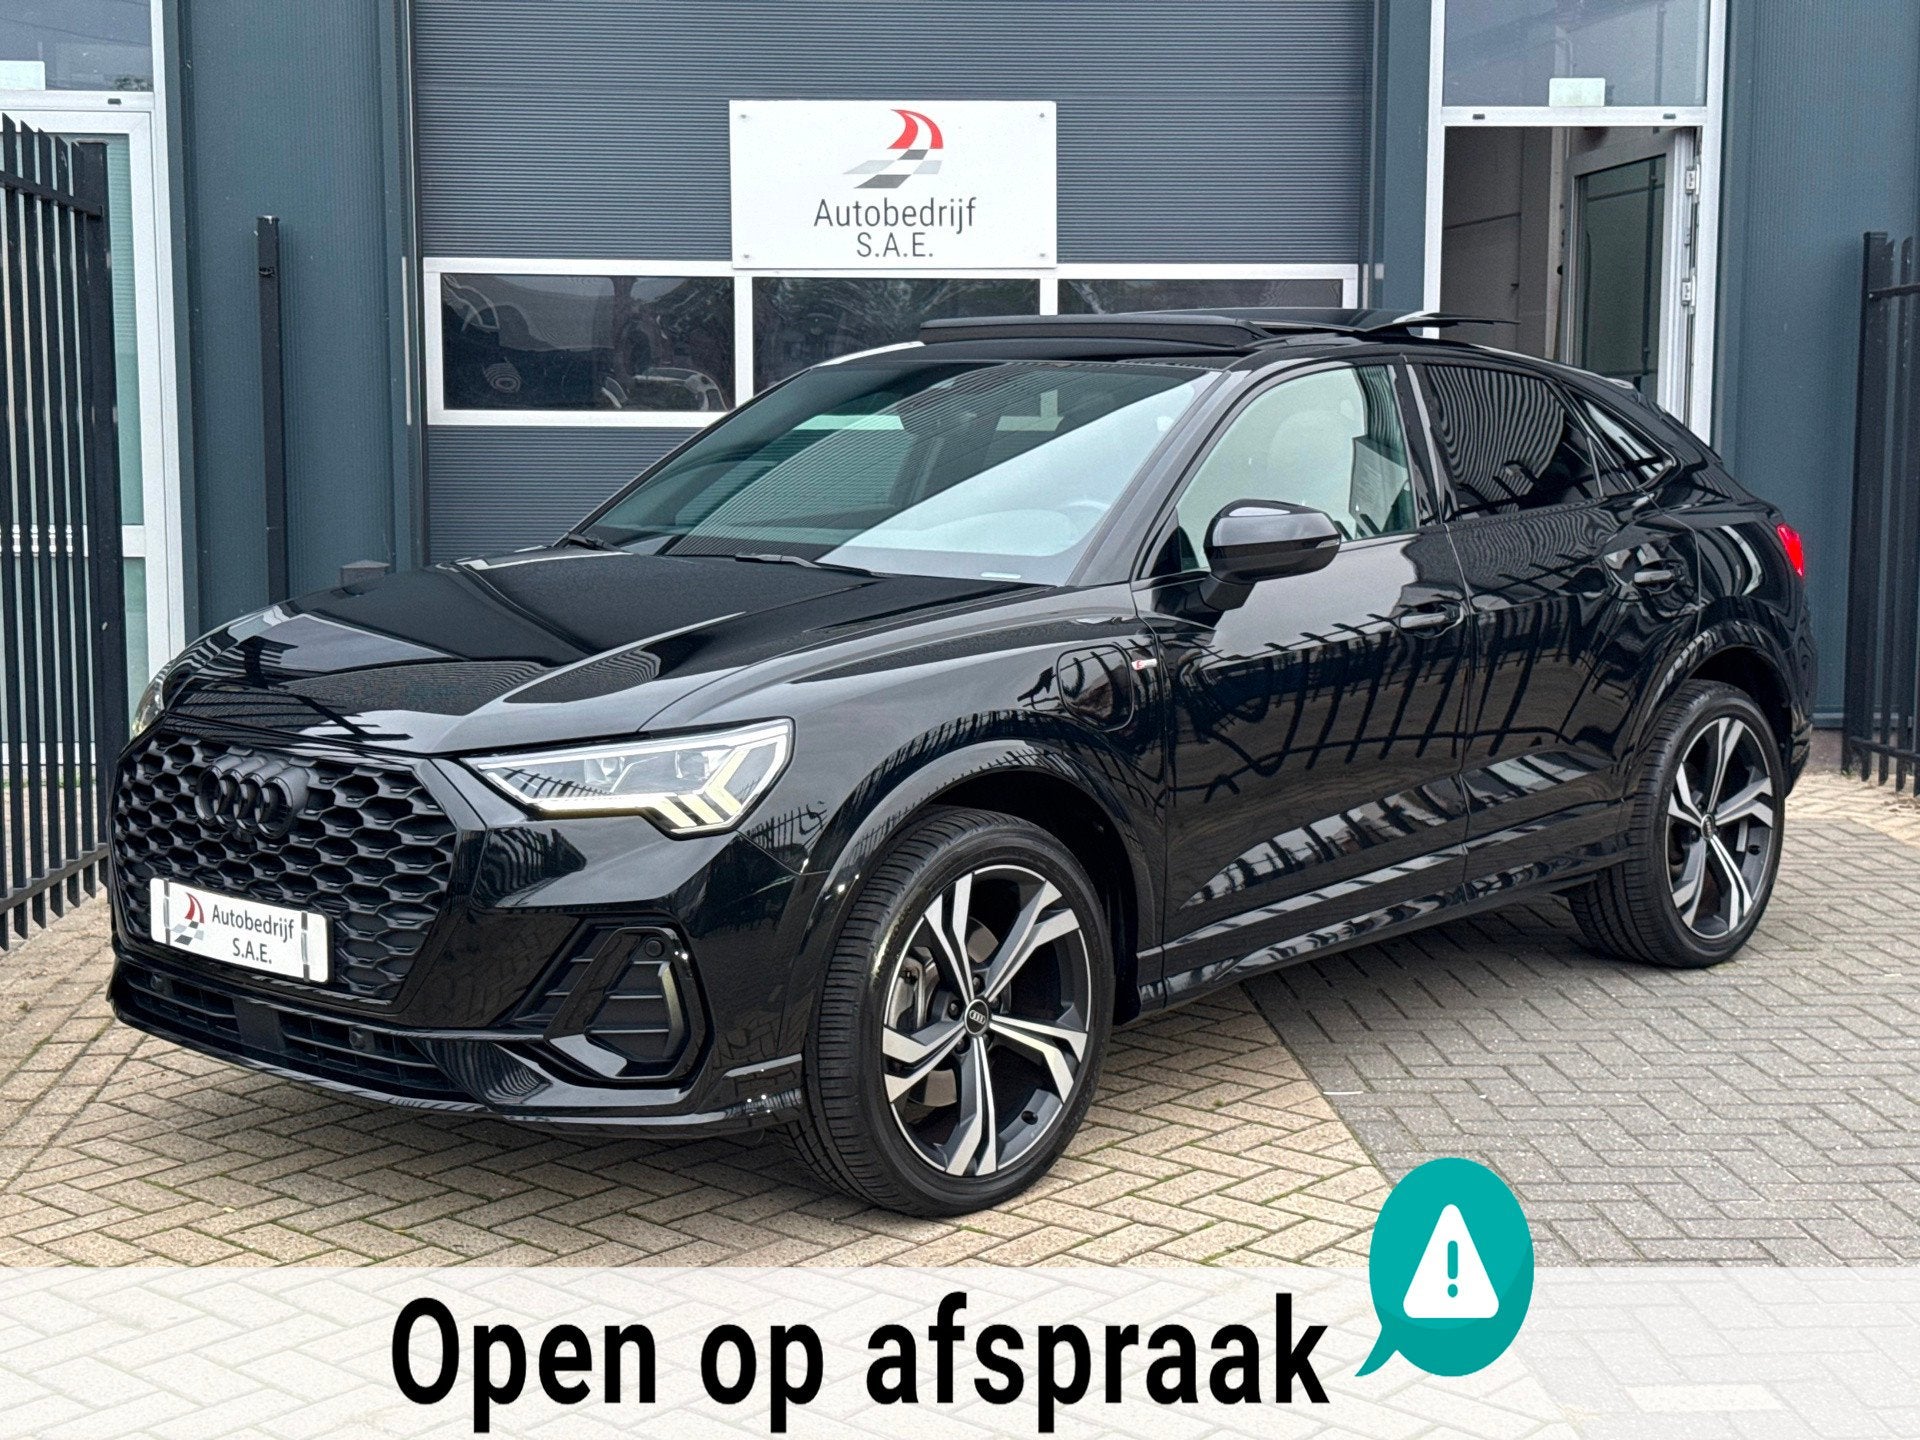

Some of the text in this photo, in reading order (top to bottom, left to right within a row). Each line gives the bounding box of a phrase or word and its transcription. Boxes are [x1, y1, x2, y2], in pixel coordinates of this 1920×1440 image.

[813, 197, 977, 234] Autobedrijf
[856, 232, 933, 257] S.A.E.
[212, 904, 294, 943] Autobedrijf
[232, 938, 273, 964] S.A.E.
